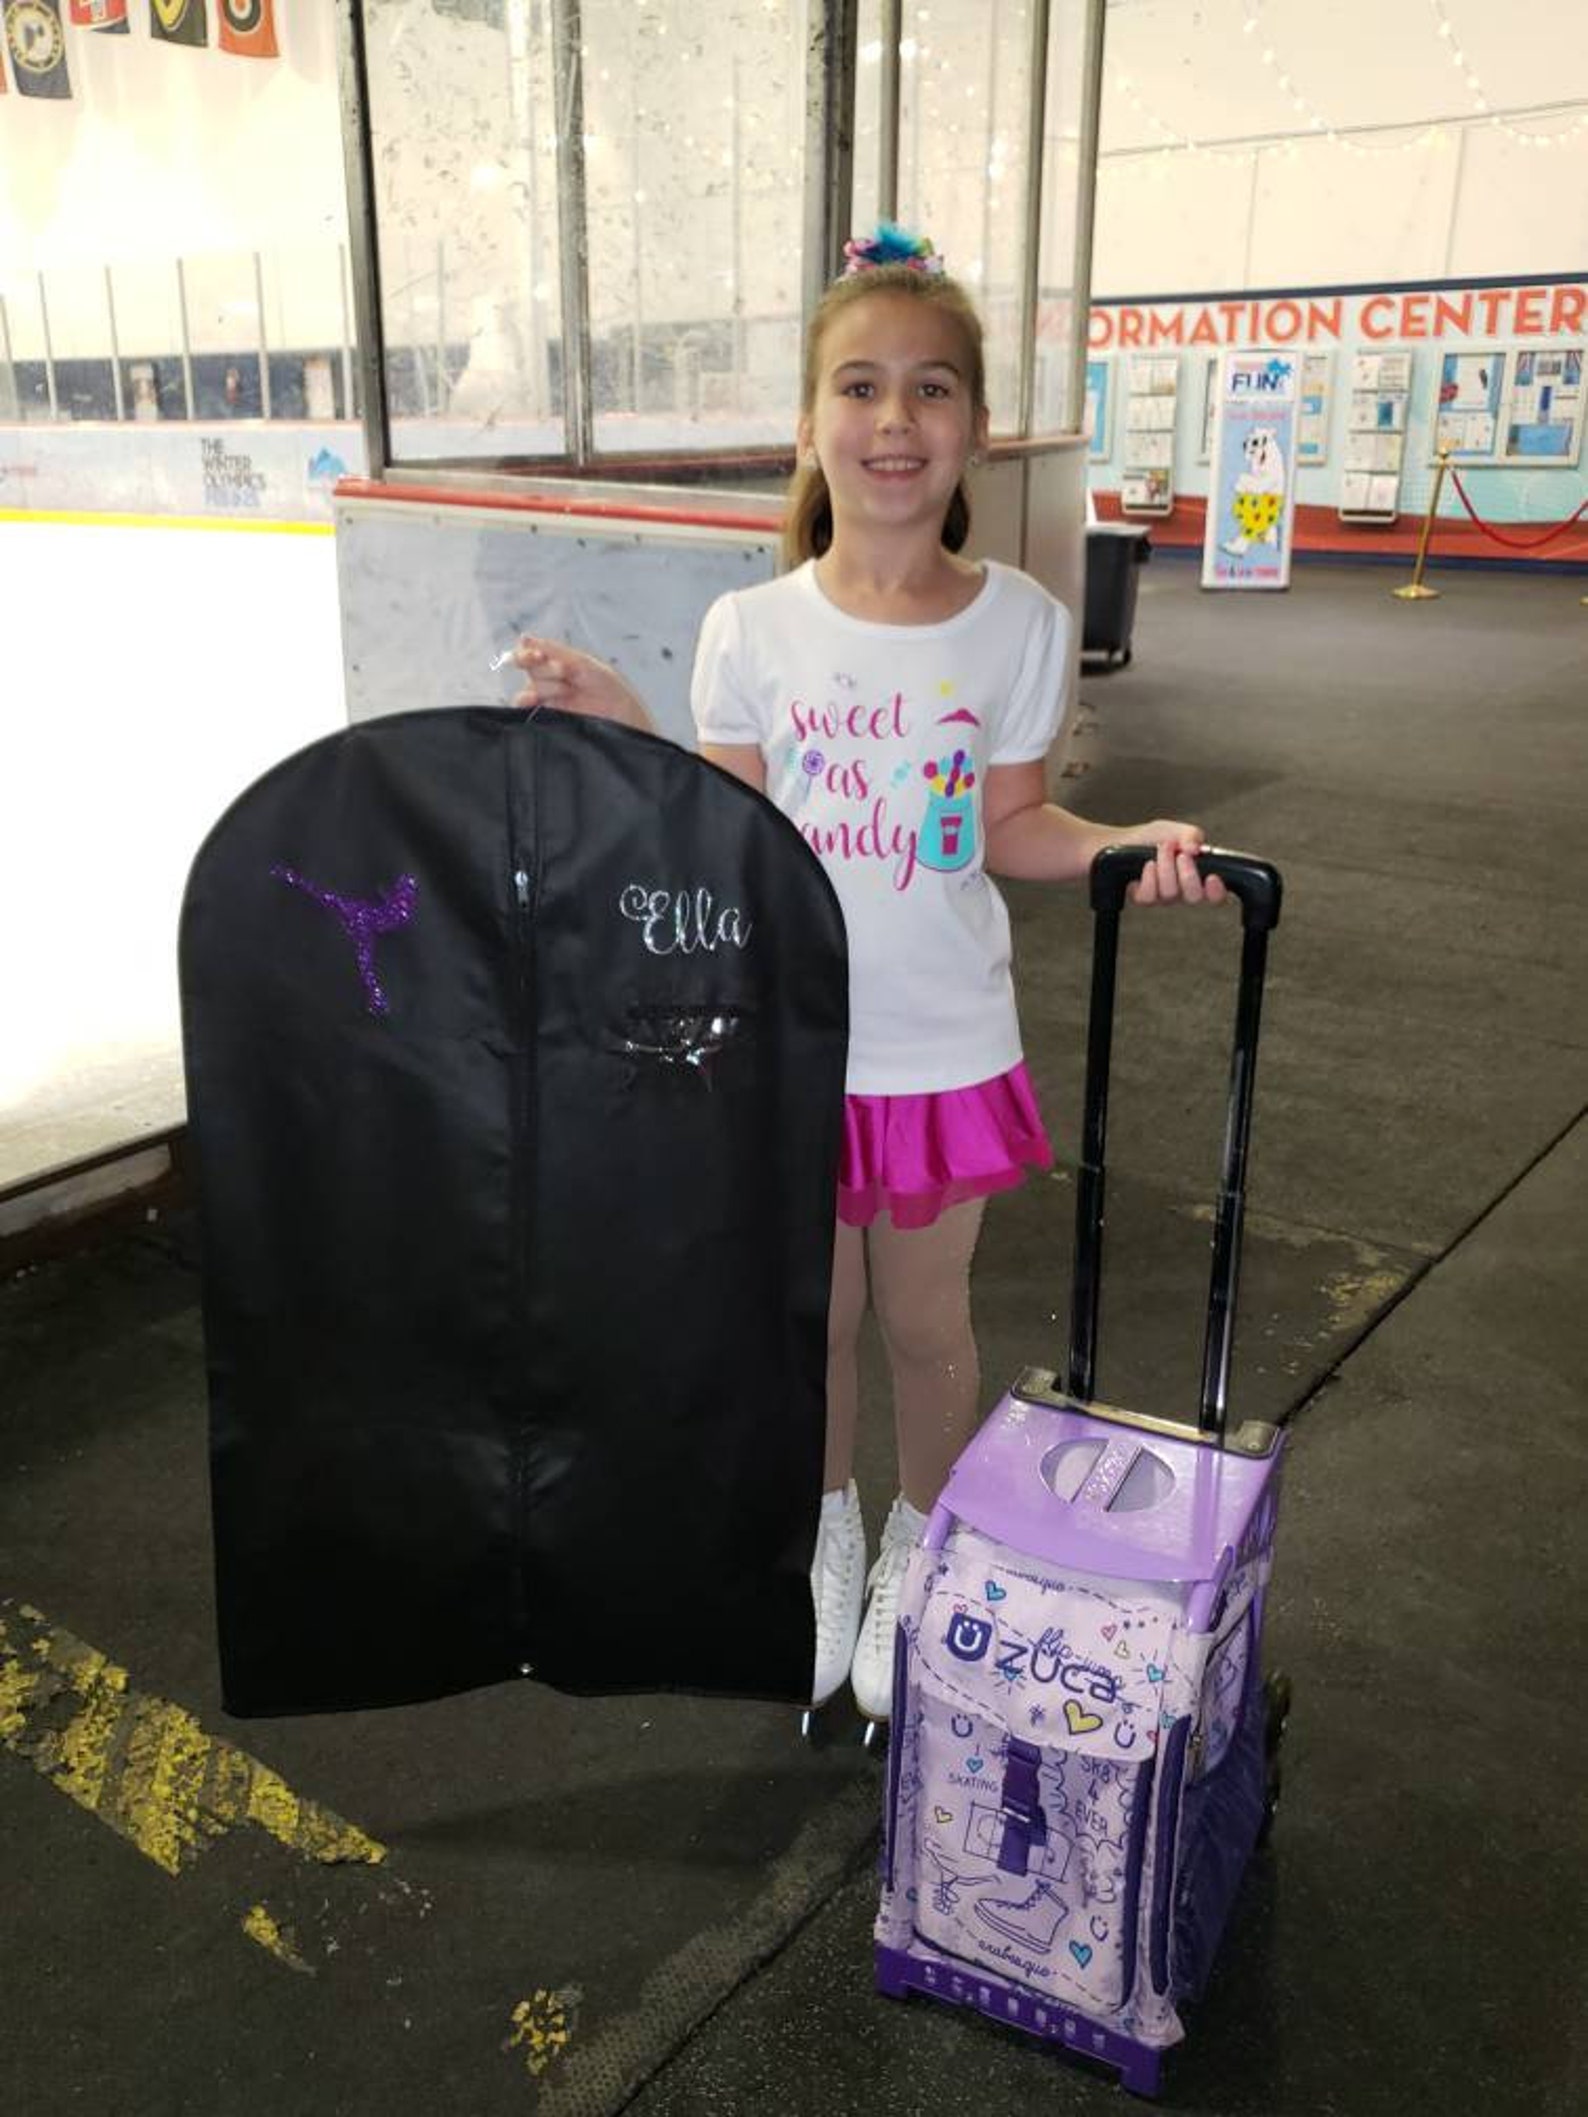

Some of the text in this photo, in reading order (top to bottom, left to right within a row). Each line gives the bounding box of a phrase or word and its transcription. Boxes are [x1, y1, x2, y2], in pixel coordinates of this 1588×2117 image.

[1360, 287, 1587, 339] CENTER
[791, 692, 906, 741] sweet
[826, 759, 868, 800] as
[802, 796, 917, 891] andy
[619, 883, 752, 955] Ella
[948, 1772, 999, 1793] SKATING
[1075, 1799, 1108, 1837] EVER
